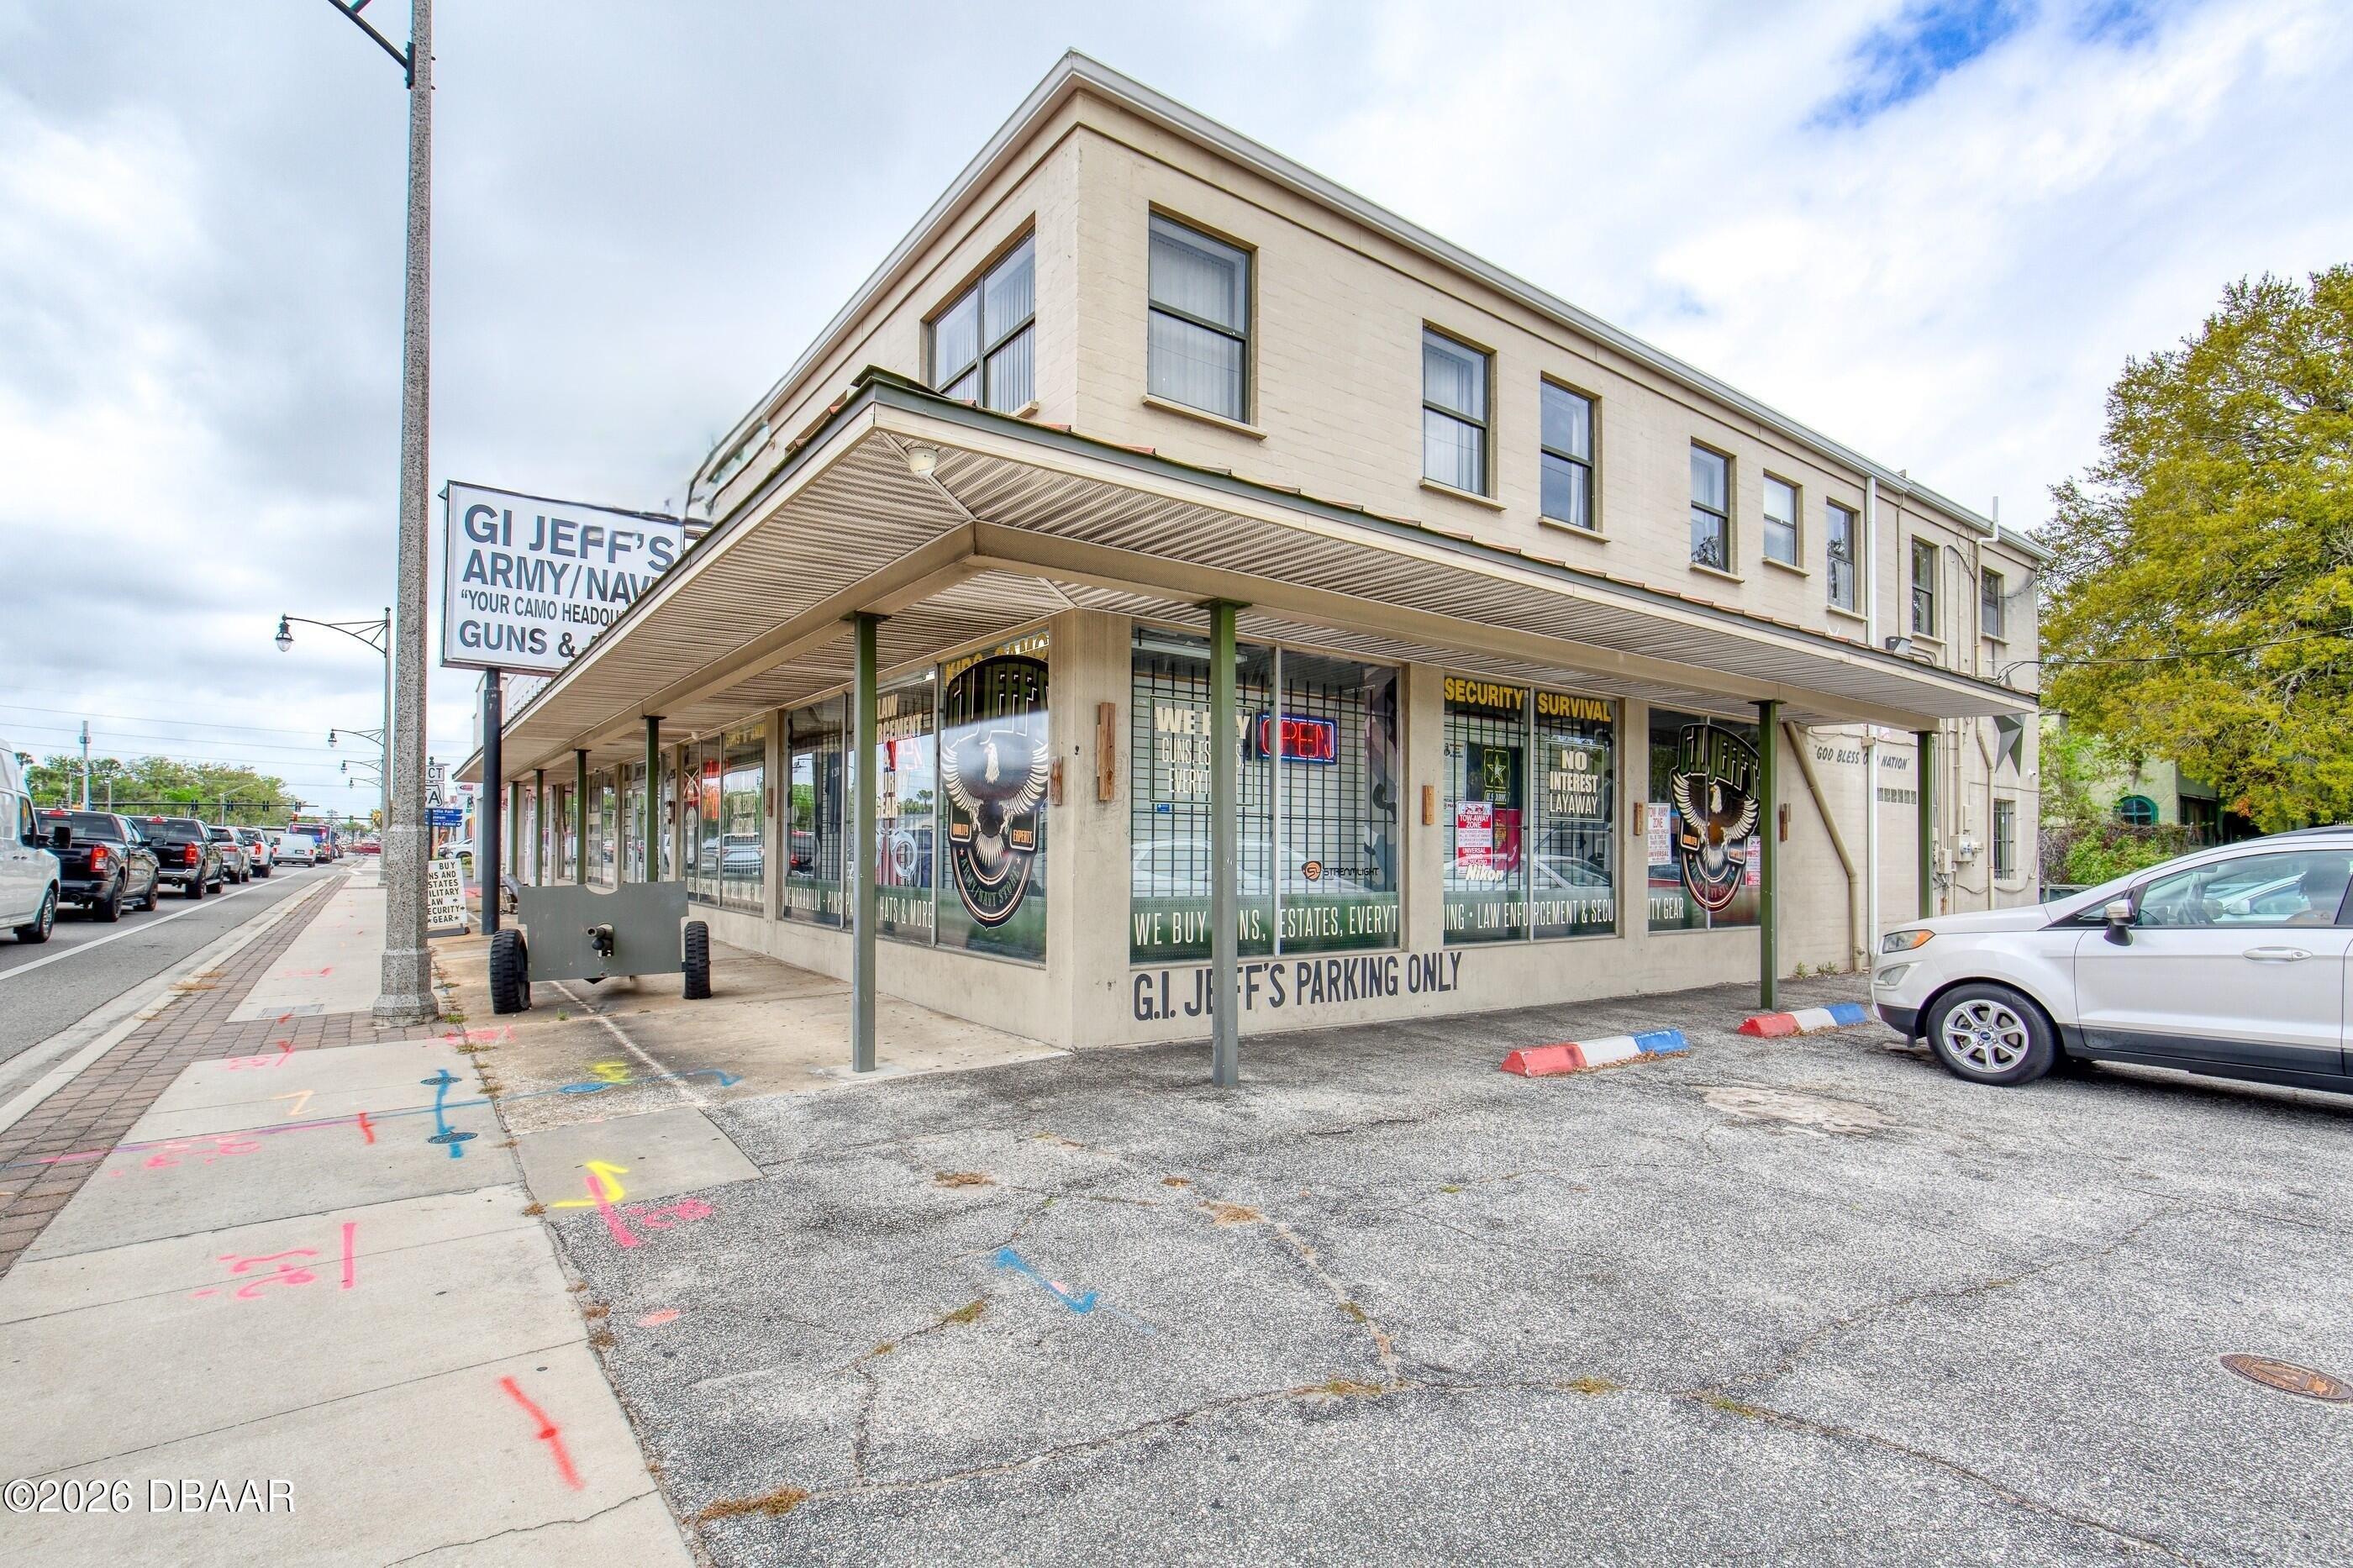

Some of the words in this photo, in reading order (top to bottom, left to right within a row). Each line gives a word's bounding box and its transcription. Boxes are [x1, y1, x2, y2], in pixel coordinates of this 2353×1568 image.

[464, 504, 513, 547] GI
[529, 514, 675, 573] JEFF'S
[462, 548, 655, 603] ARMY/NAV
[514, 599, 558, 620] CAMO
[459, 620, 547, 655] GUNS
[558, 632, 576, 658] &
[1445, 676, 1524, 710] SECURITY
[876, 693, 898, 720] LAW
[1538, 692, 1612, 723] SURVIVAL
[876, 713, 923, 745] RCEMENT
[1155, 706, 1196, 735] WE
[1261, 718, 1332, 760] OPEN
[1561, 750, 1587, 771] NO
[1836, 749, 1860, 765] BLESS
[428, 767, 443, 779] CT
[1168, 767, 1210, 794] EVERYT
[1550, 771, 1598, 794] INTEREST
[1550, 794, 1598, 815] LAYAWAY
[1459, 814, 1489, 823] TOW-AWAY
[429, 871, 439, 880] NS
[439, 861, 455, 871] BUY
[1324, 867, 1380, 877] STREAMLIGHT
[1465, 864, 1504, 881] Nikon
[428, 878, 459, 889] STATES
[429, 887, 459, 897] ILITARY
[998, 866, 1020, 904] STORE
[428, 905, 460, 916] ECURITY
[784, 886, 821, 912] MEMORABILIA
[827, 891, 841, 915] PINS
[1663, 897, 1684, 920] GEAR
[433, 914, 454, 923] GEAR
[879, 896, 898, 923] HATS
[901, 898, 907, 924] &
[909, 899, 933, 929] MORE
[1477, 902, 1500, 929] LAW
[1503, 898, 1578, 928] ENFORCEMENT
[1581, 899, 1588, 923] &
[1134, 913, 1162, 946] WE
[1171, 910, 1207, 944] BUY
[1240, 908, 1266, 942] NS,
[1279, 907, 1344, 939] ESTATES,
[1134, 970, 1176, 1021] G.I.
[1297, 955, 1399, 1006] PARKING
[1408, 951, 1463, 995] ONLY
